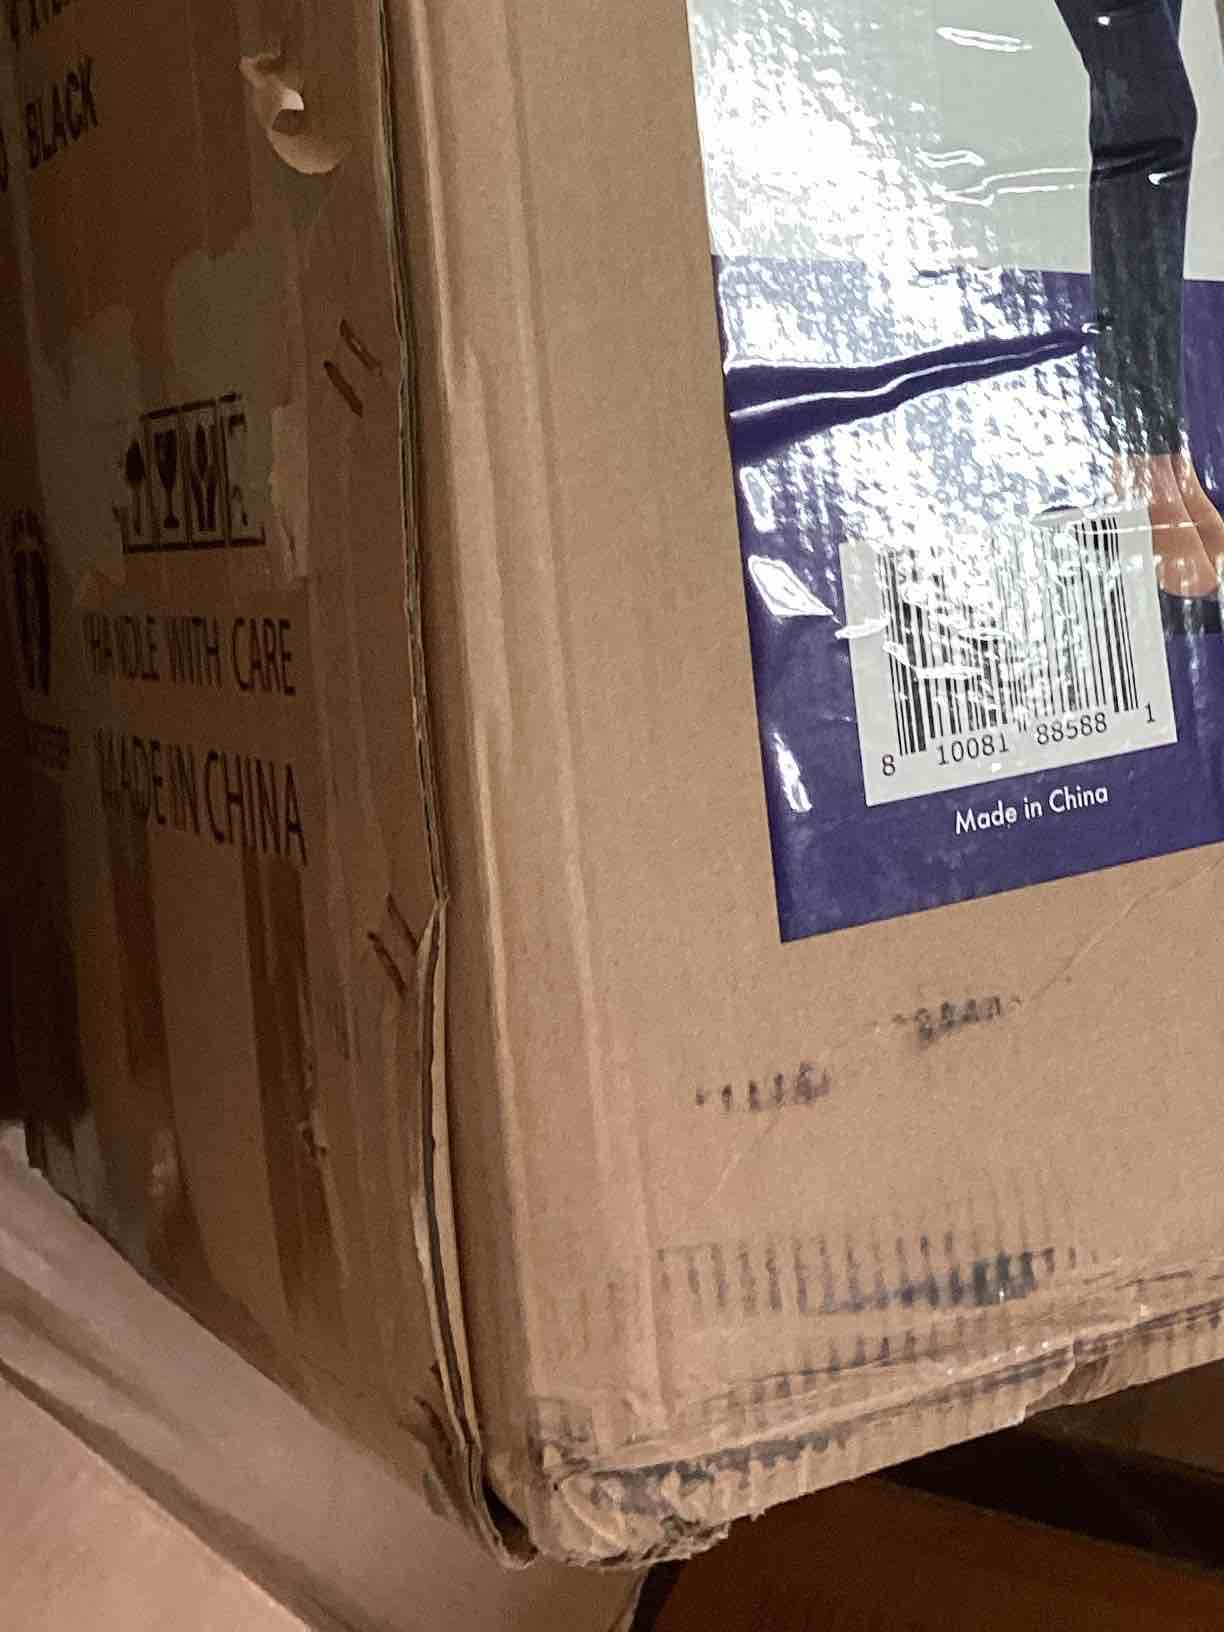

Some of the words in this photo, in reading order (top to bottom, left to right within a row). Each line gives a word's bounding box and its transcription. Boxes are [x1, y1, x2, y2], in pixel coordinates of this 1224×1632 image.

[25, 55, 98, 169] BLACK
[167, 616, 223, 689] WITH
[232, 616, 297, 696] CARE
[881, 753, 896, 777] 8
[936, 732, 1010, 766] 10081
[1036, 712, 1108, 746] 88588
[1145, 704, 1157, 723] 1
[94, 728, 167, 828] MADE
[204, 749, 308, 869] CHINA
[955, 800, 1018, 835] Made
[1023, 796, 1043, 820] in
[1049, 785, 1109, 814] China
